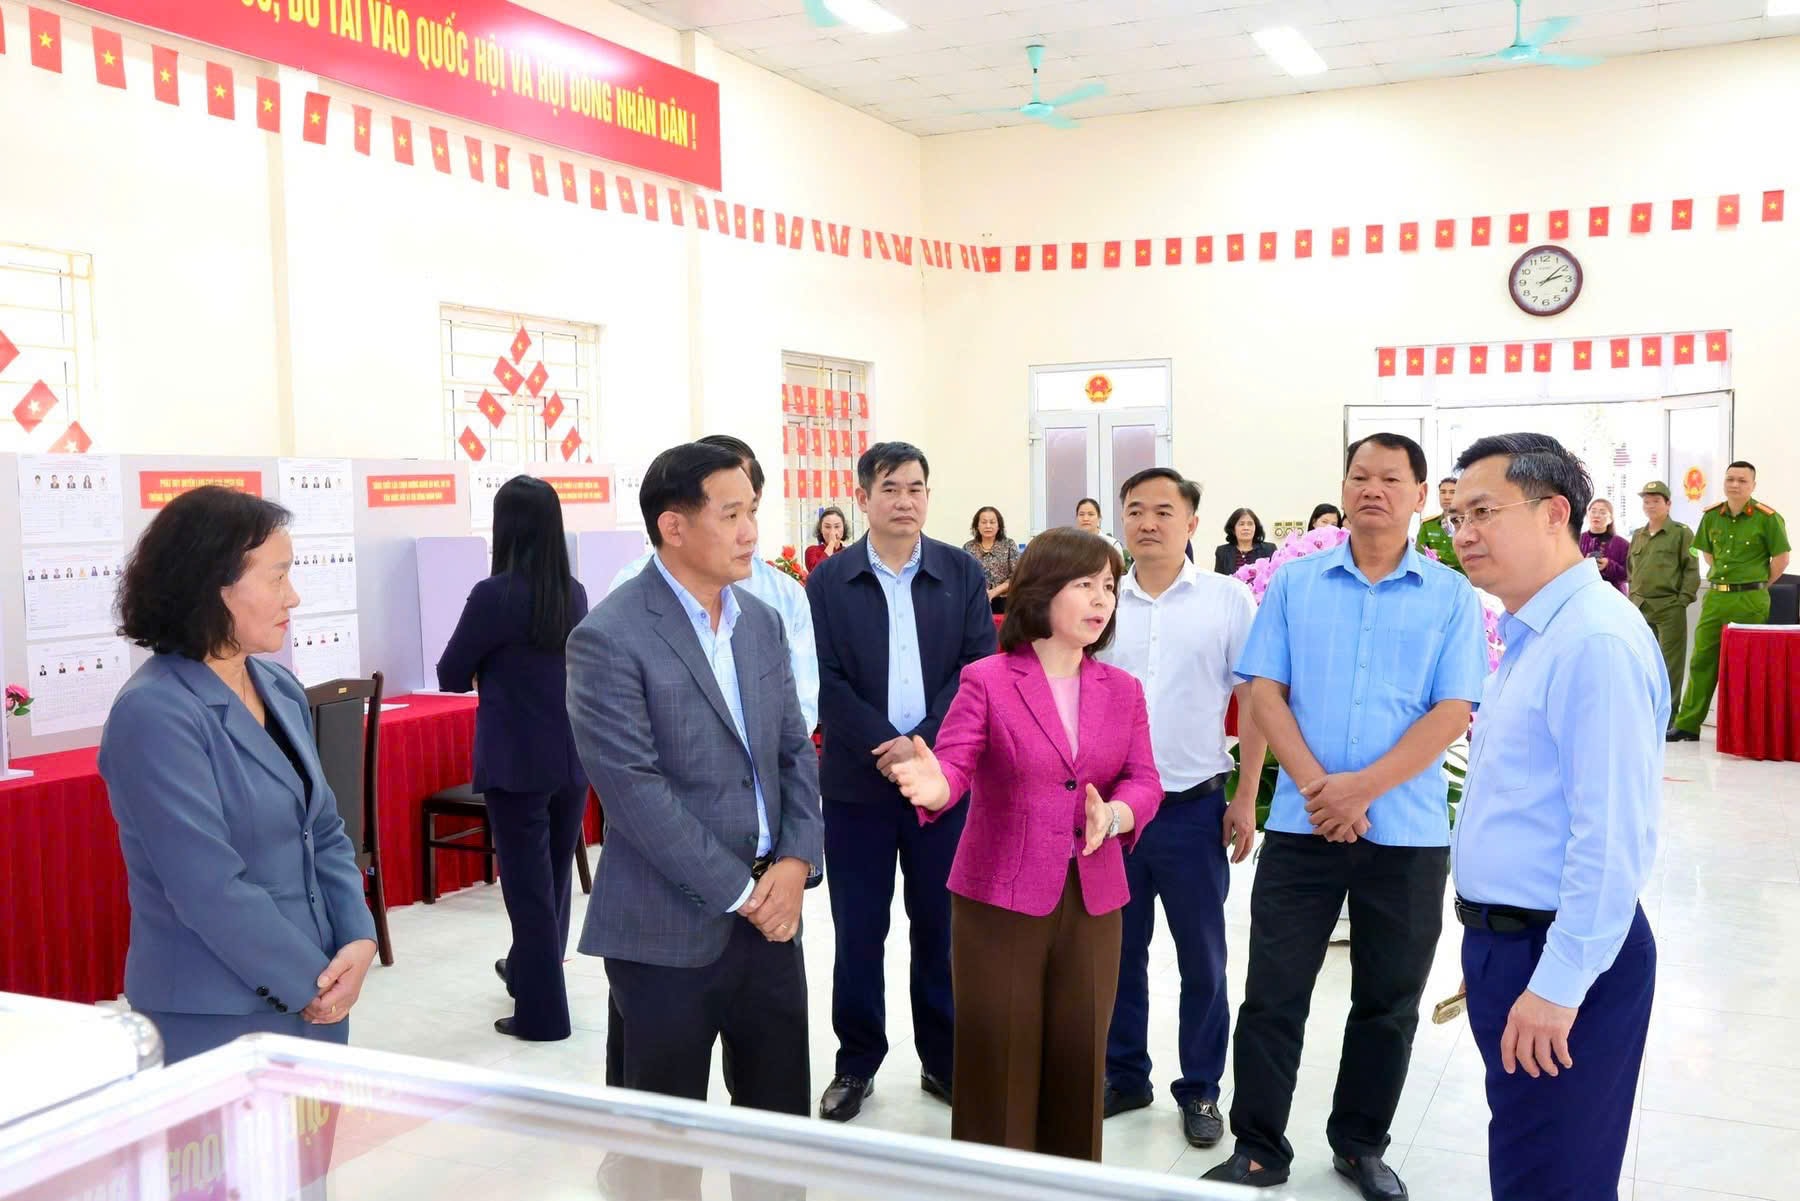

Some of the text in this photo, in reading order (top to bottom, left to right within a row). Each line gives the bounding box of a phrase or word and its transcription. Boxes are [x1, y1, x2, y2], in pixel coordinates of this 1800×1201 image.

[416, 11, 469, 77] QUỐC
[474, 33, 506, 96] HỘI
[616, 86, 657, 137] NHÂN
[660, 97, 689, 148] DÂN
[691, 112, 698, 151] !
